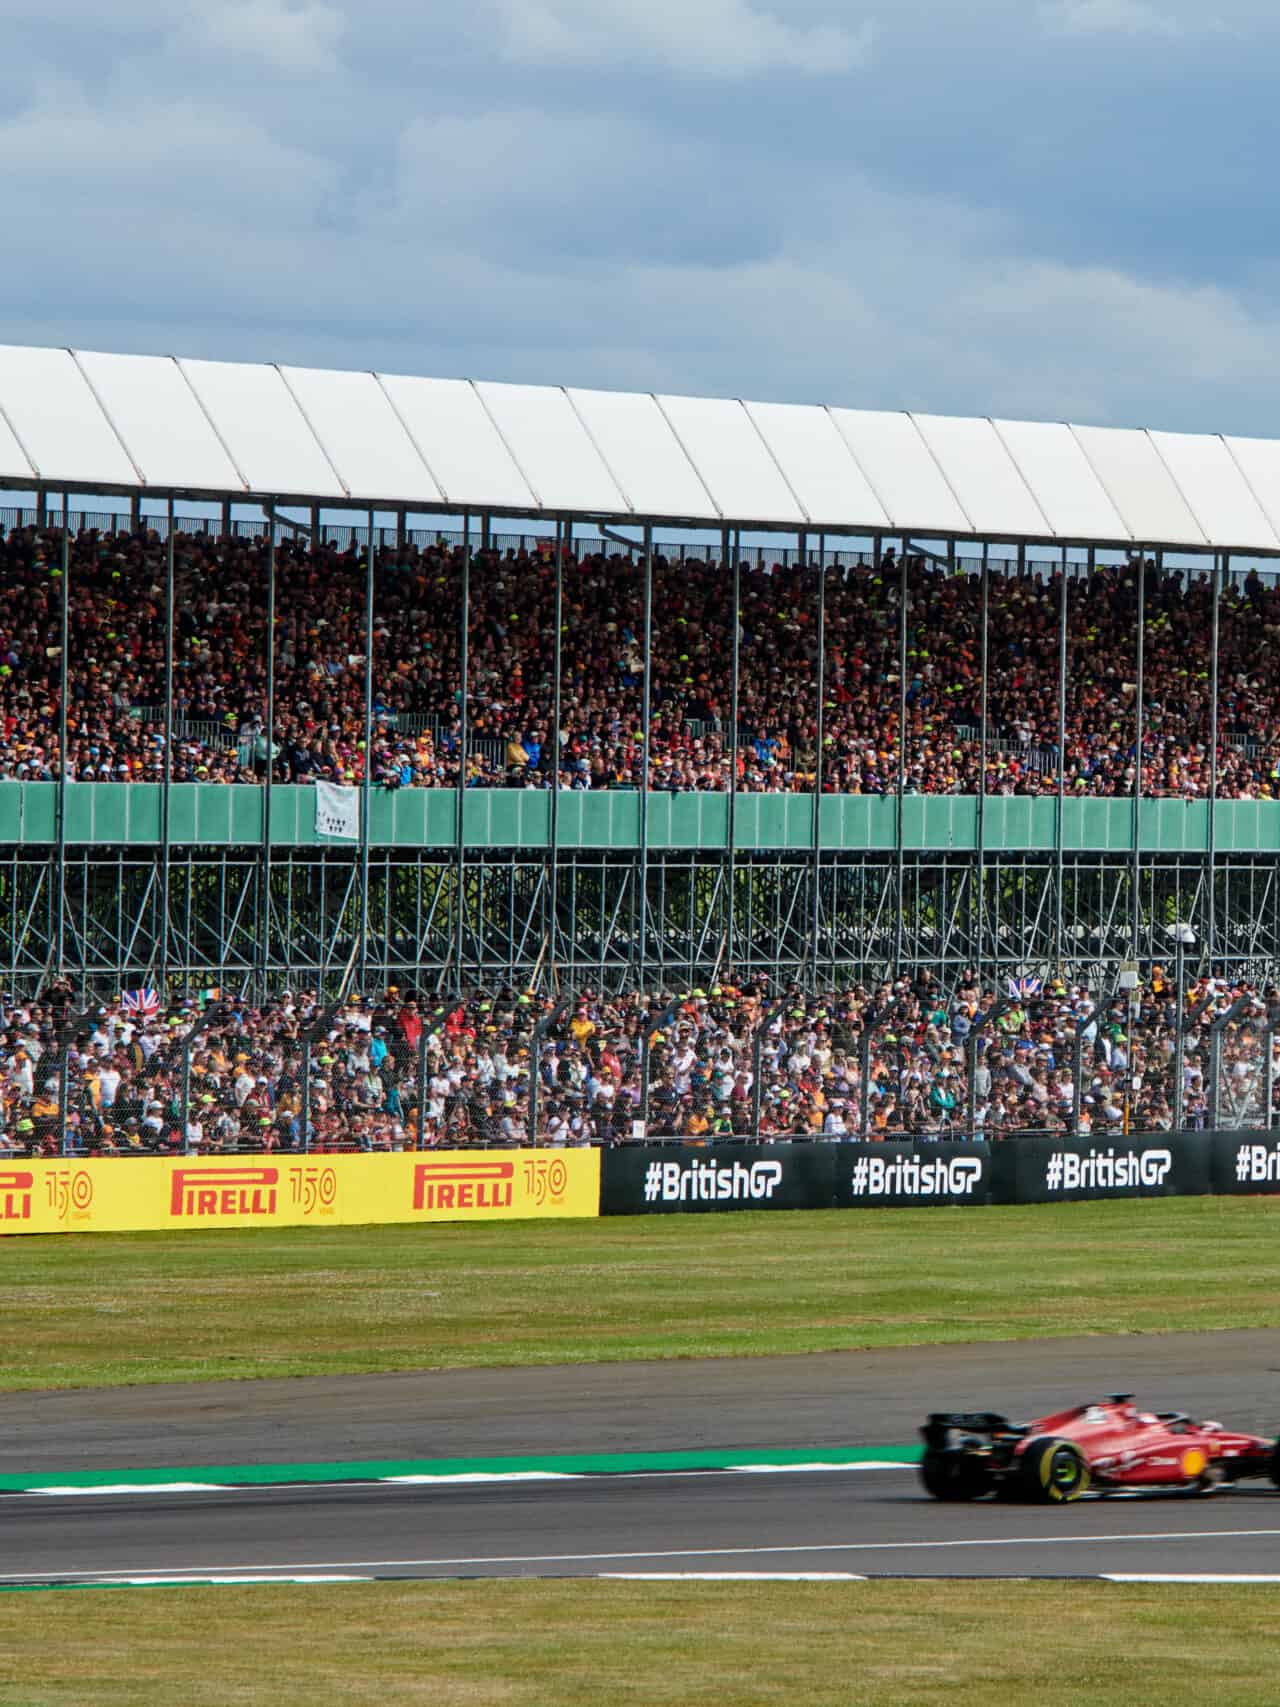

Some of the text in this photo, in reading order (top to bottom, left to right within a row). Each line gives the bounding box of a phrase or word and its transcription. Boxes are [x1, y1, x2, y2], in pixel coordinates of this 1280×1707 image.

[170, 1167, 337, 1216] PIRELLI 150
[413, 1159, 567, 1209] PIRELLI 150
[644, 1158, 783, 1201] #BritishGP
[852, 1154, 982, 1195] #BritishGP
[1046, 1148, 1172, 1190] #BritishGP
[45, 1170, 93, 1220] 150
